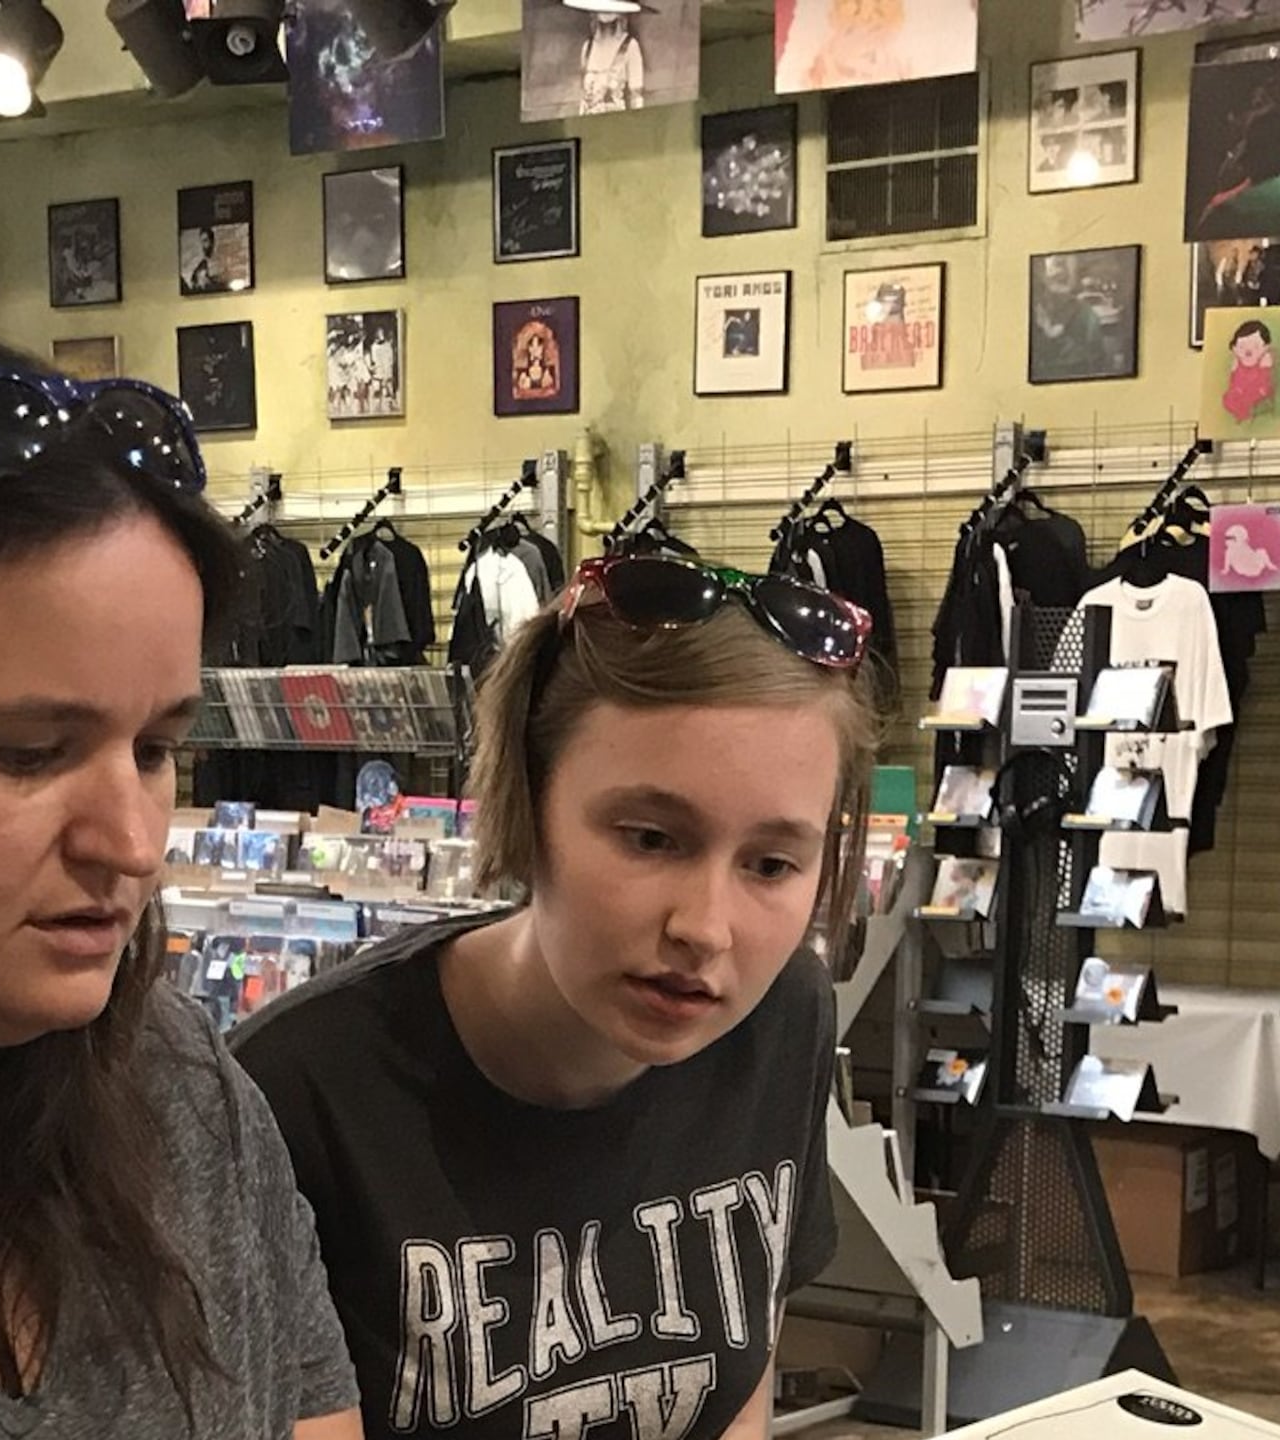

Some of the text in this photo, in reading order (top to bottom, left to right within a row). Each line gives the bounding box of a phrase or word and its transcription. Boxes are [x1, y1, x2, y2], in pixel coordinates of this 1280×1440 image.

[703, 280, 783, 299] TORI AMOS
[388, 1159, 798, 1435] REALITY
